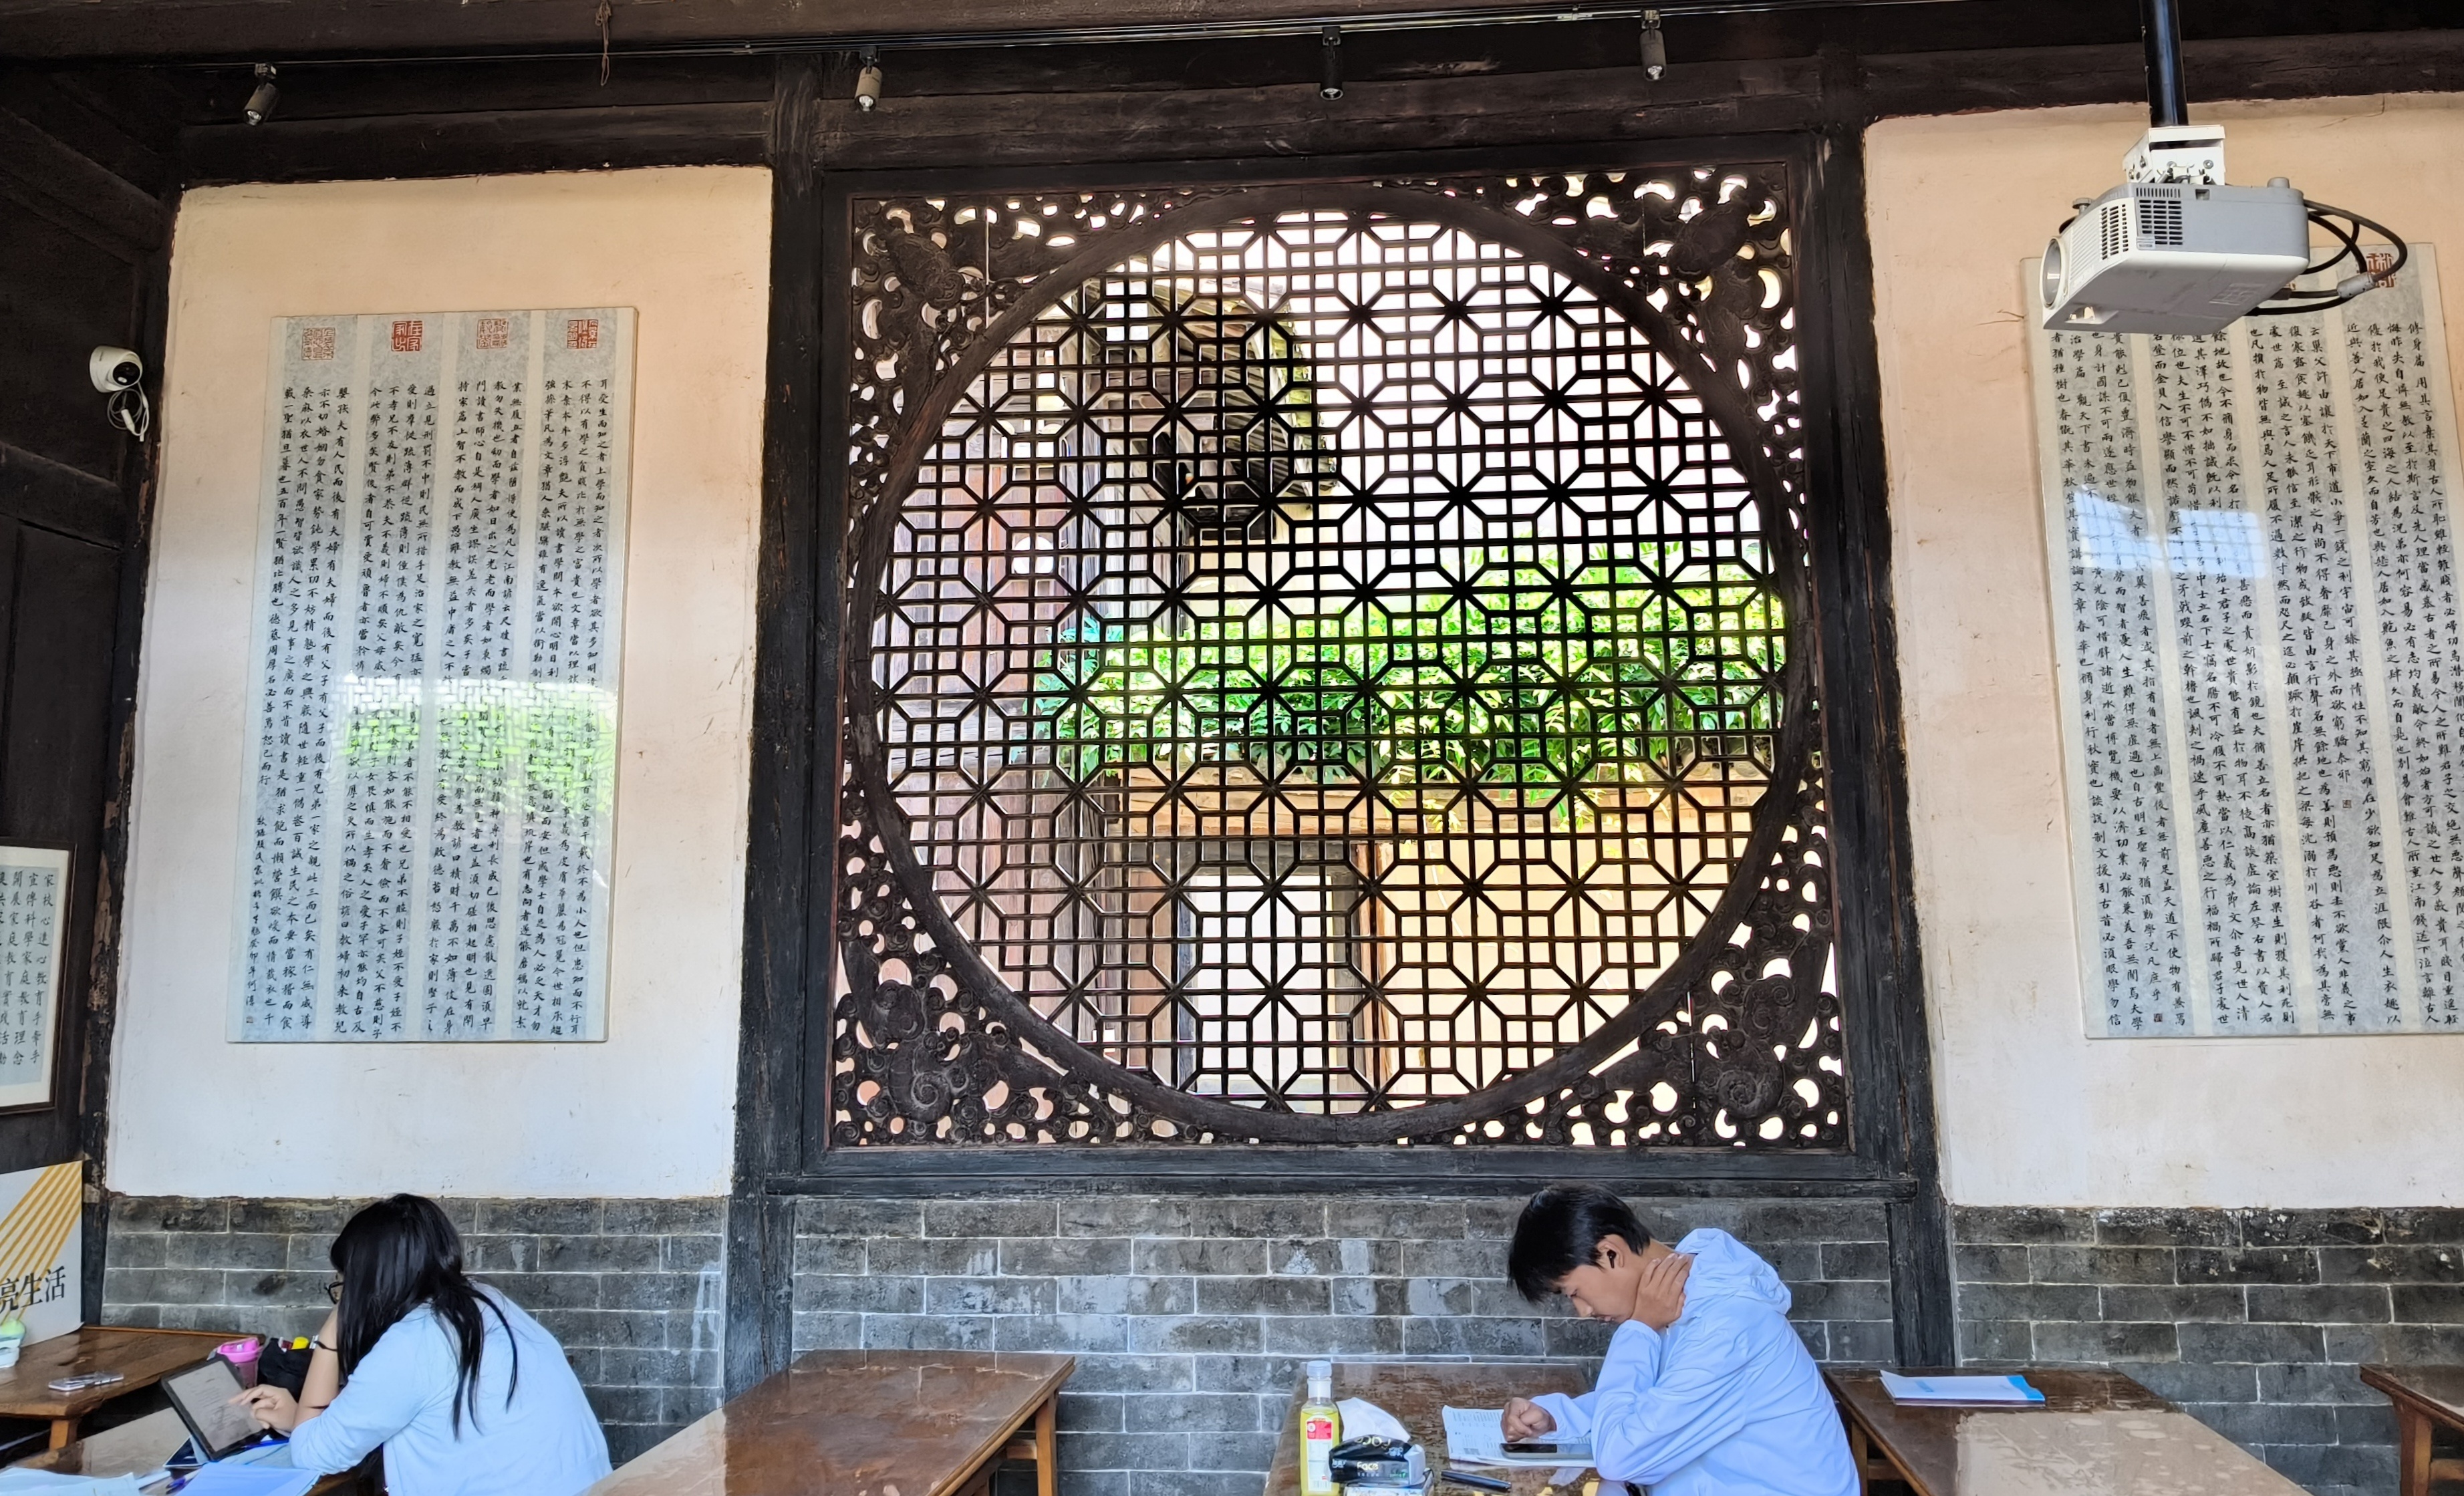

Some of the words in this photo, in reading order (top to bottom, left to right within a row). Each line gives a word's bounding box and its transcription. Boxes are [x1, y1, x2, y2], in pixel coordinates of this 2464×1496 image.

[2068, 335, 2089, 379] 治學篇
[2267, 325, 2286, 369] 處世篇
[2406, 321, 2427, 367] 修身篇
[13, 872, 39, 1066] 宣傳科學家庭教育理念
[1356, 1461, 1379, 1471] Face
